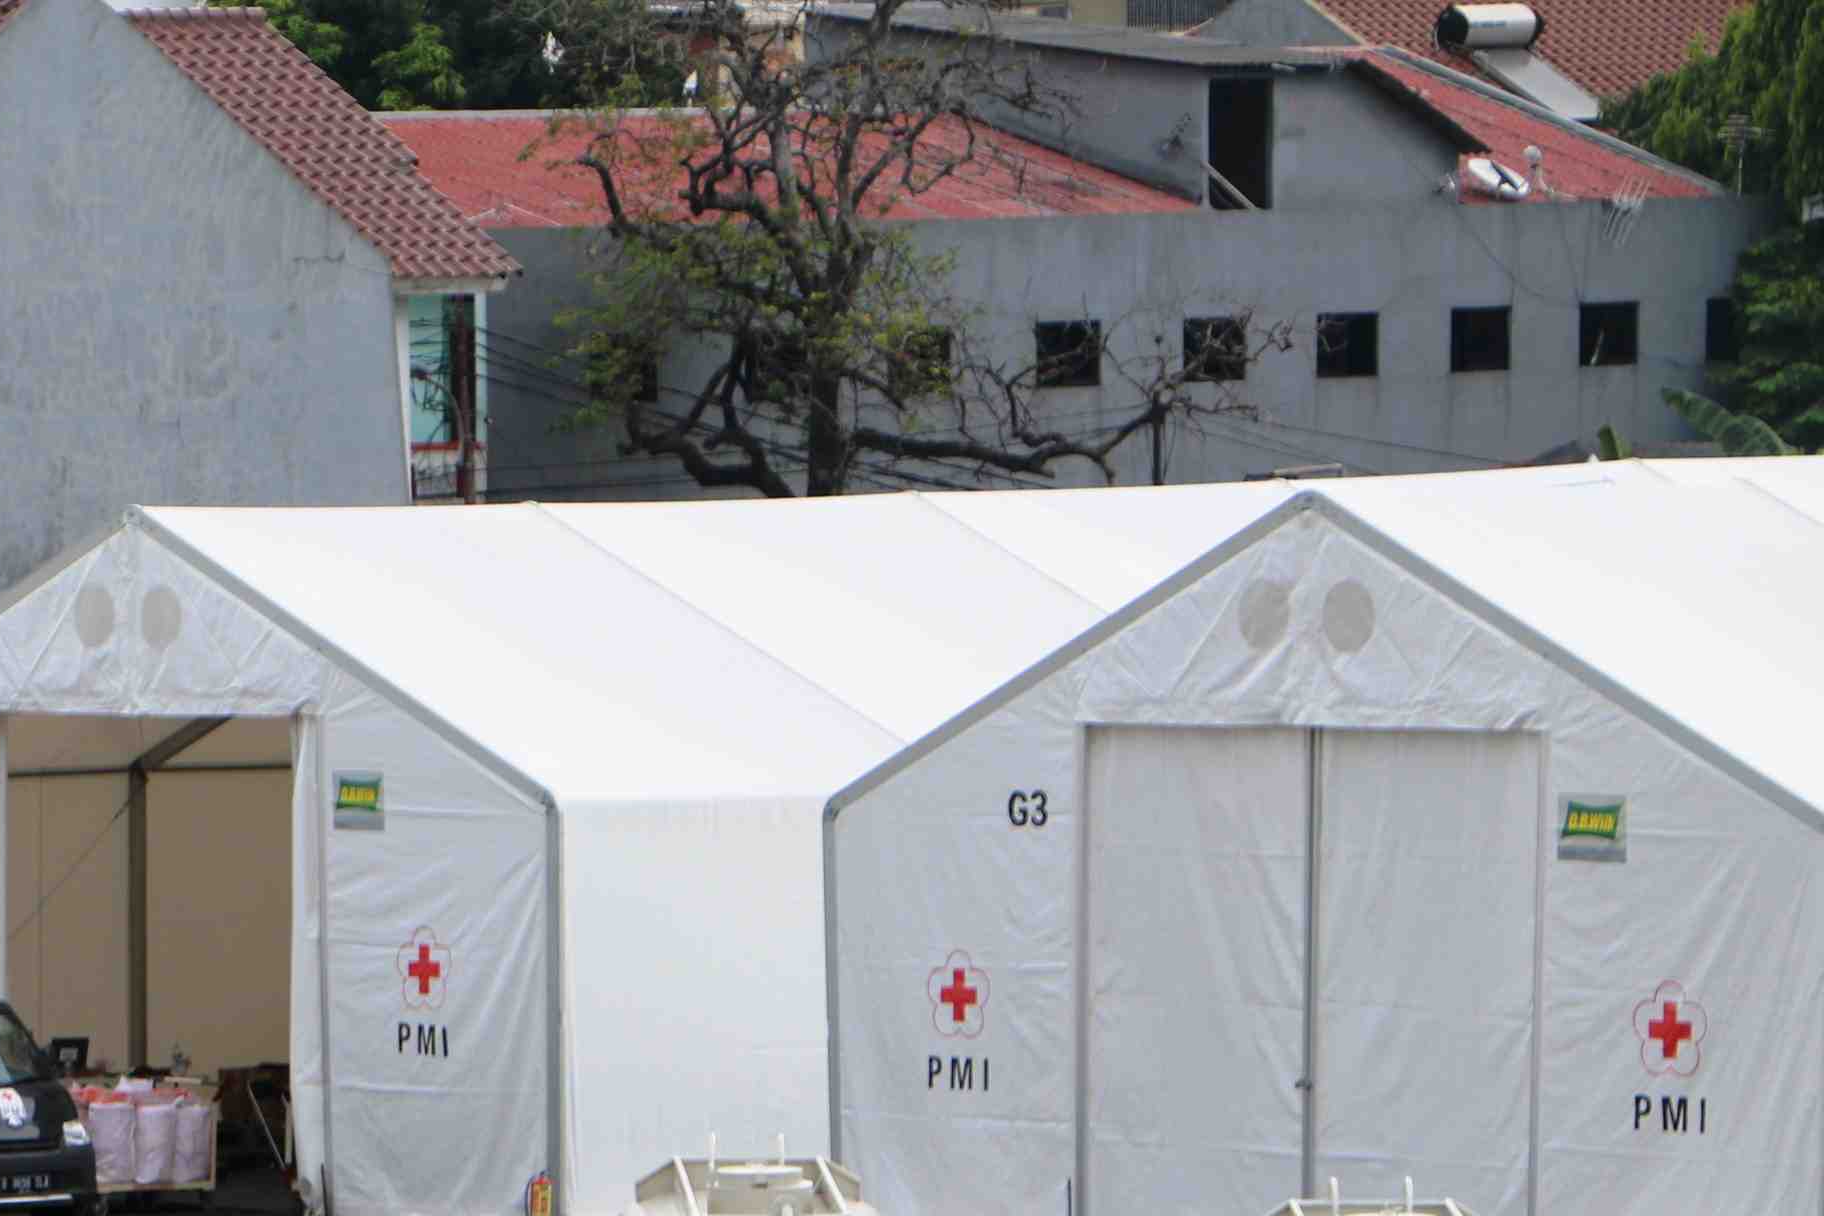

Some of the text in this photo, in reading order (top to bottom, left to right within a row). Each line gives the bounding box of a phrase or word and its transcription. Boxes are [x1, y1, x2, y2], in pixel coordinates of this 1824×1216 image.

[1008, 790, 1048, 826] G3
[398, 1022, 449, 1058] PMI
[928, 1054, 990, 1091] PMI
[1634, 1094, 1707, 1134] PMI
